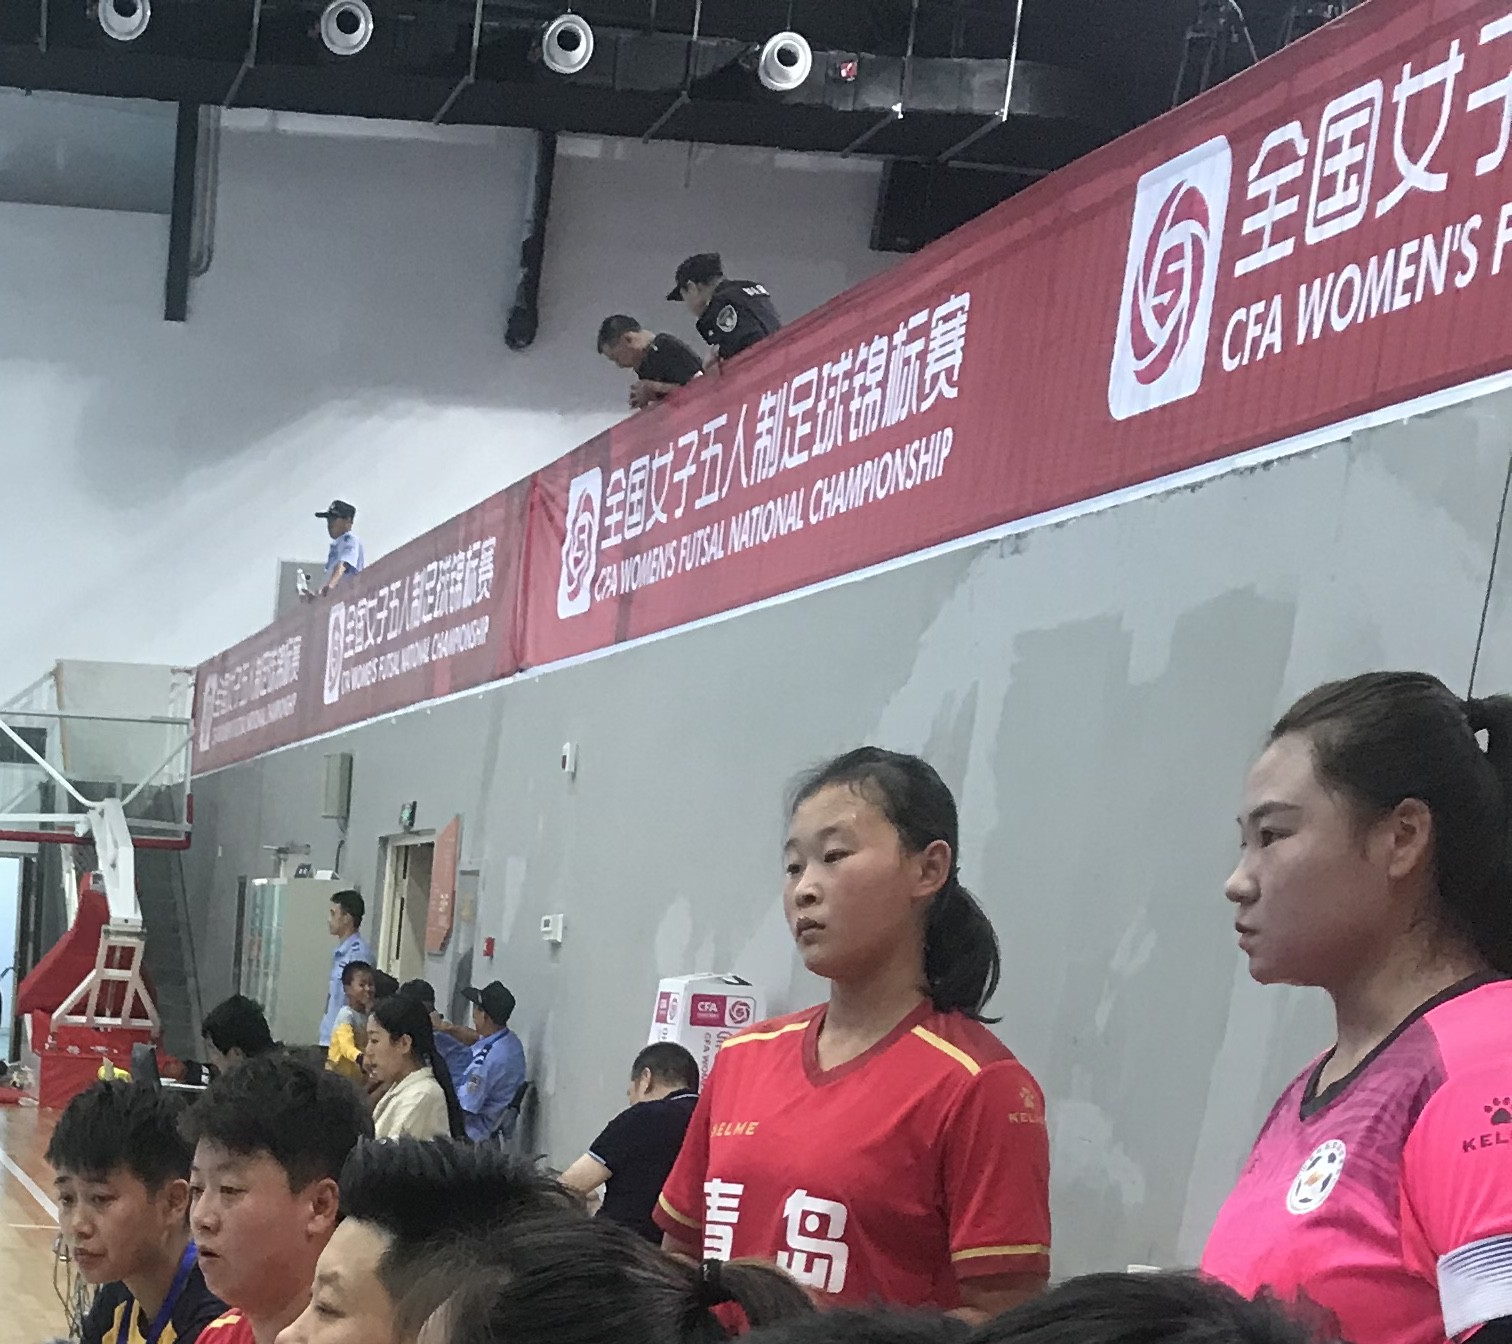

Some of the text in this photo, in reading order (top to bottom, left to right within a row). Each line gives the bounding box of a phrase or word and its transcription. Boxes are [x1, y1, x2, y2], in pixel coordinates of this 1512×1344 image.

[1222, 295, 1283, 371] CFA
[1296, 214, 1482, 345] WOMEN'S
[599, 291, 971, 549] 全国女子五人制足球锦标赛
[595, 427, 954, 602] CFA WOMEN'S FUTSAL NATIONAL CHAMPIONSHIP
[697, 1001, 718, 1013] CFA
